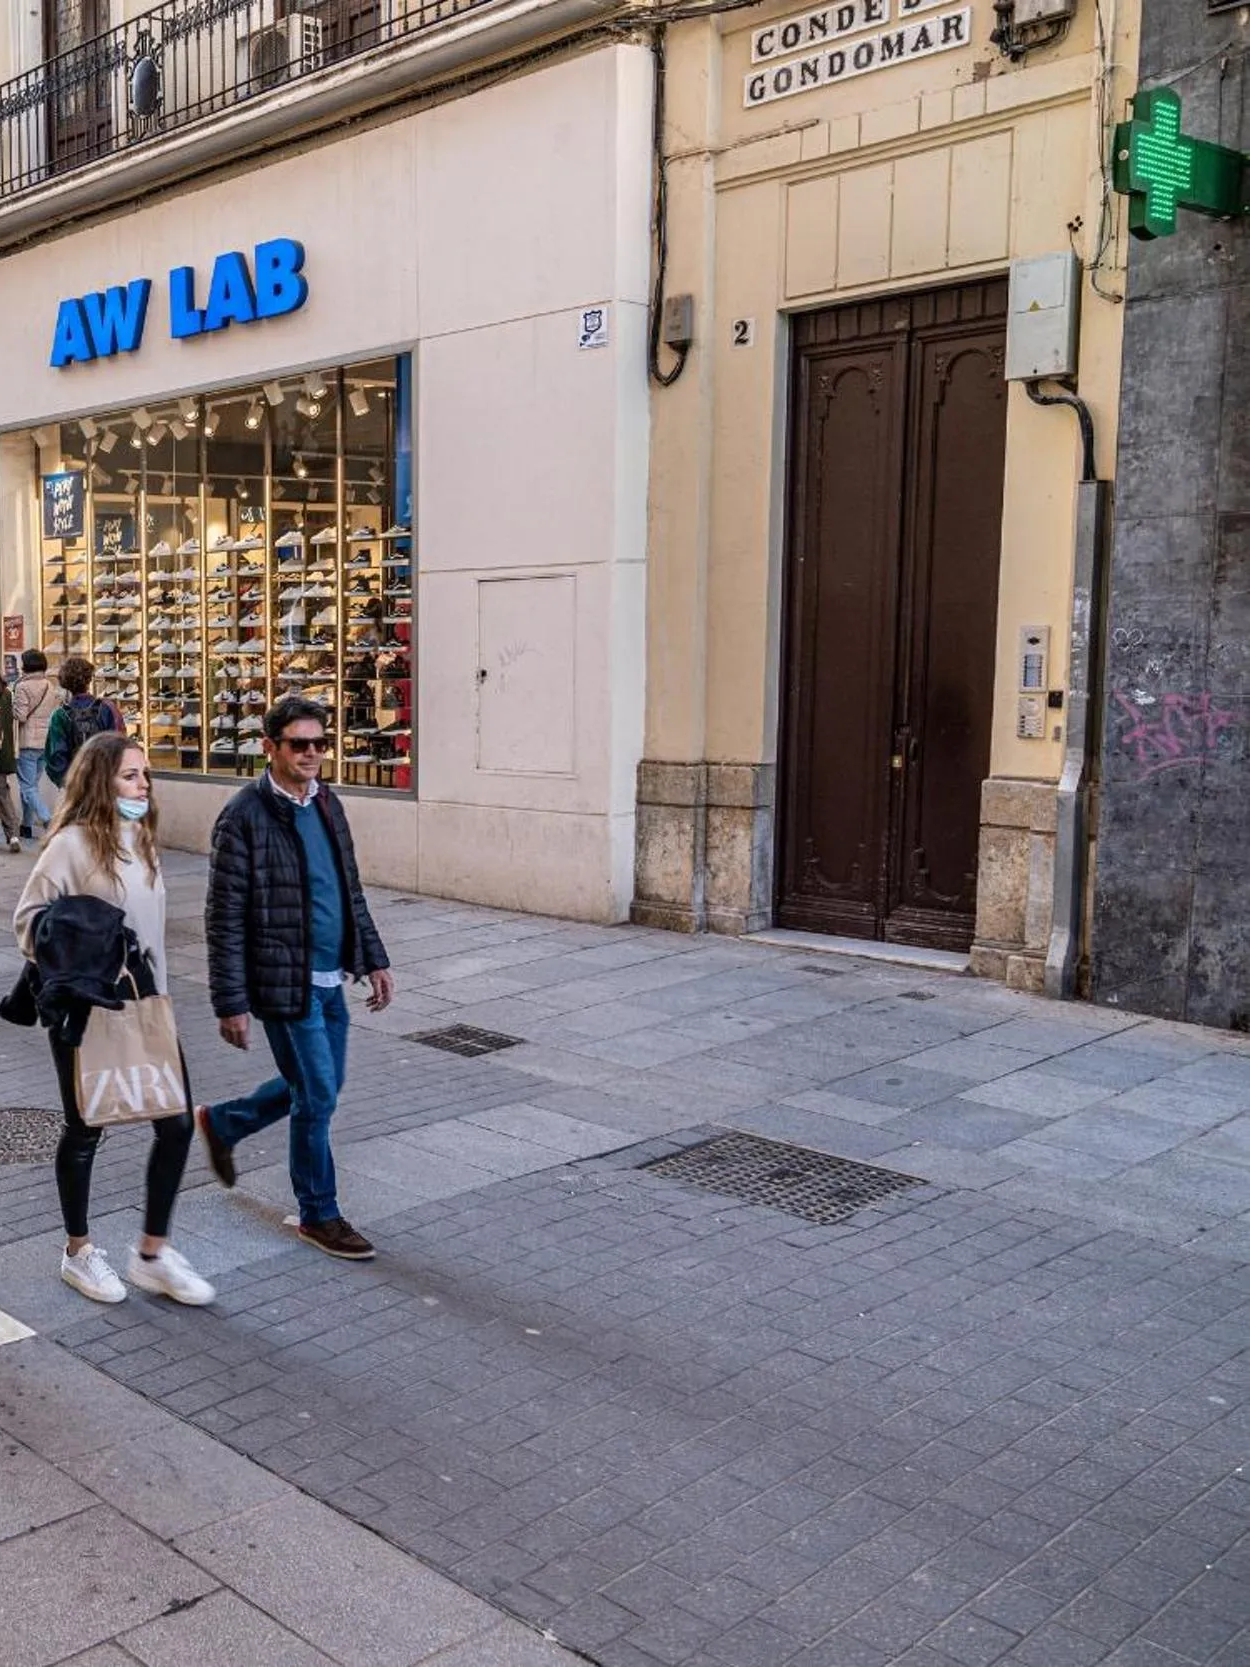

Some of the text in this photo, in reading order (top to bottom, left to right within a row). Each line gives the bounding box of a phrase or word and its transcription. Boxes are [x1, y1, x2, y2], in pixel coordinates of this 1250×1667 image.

[756, 0, 883, 56] CONDE
[749, 14, 964, 101] GONDOMAR
[50, 238, 309, 367] AW LAB
[734, 319, 749, 345] 2
[82, 1062, 187, 1119] ZARA
